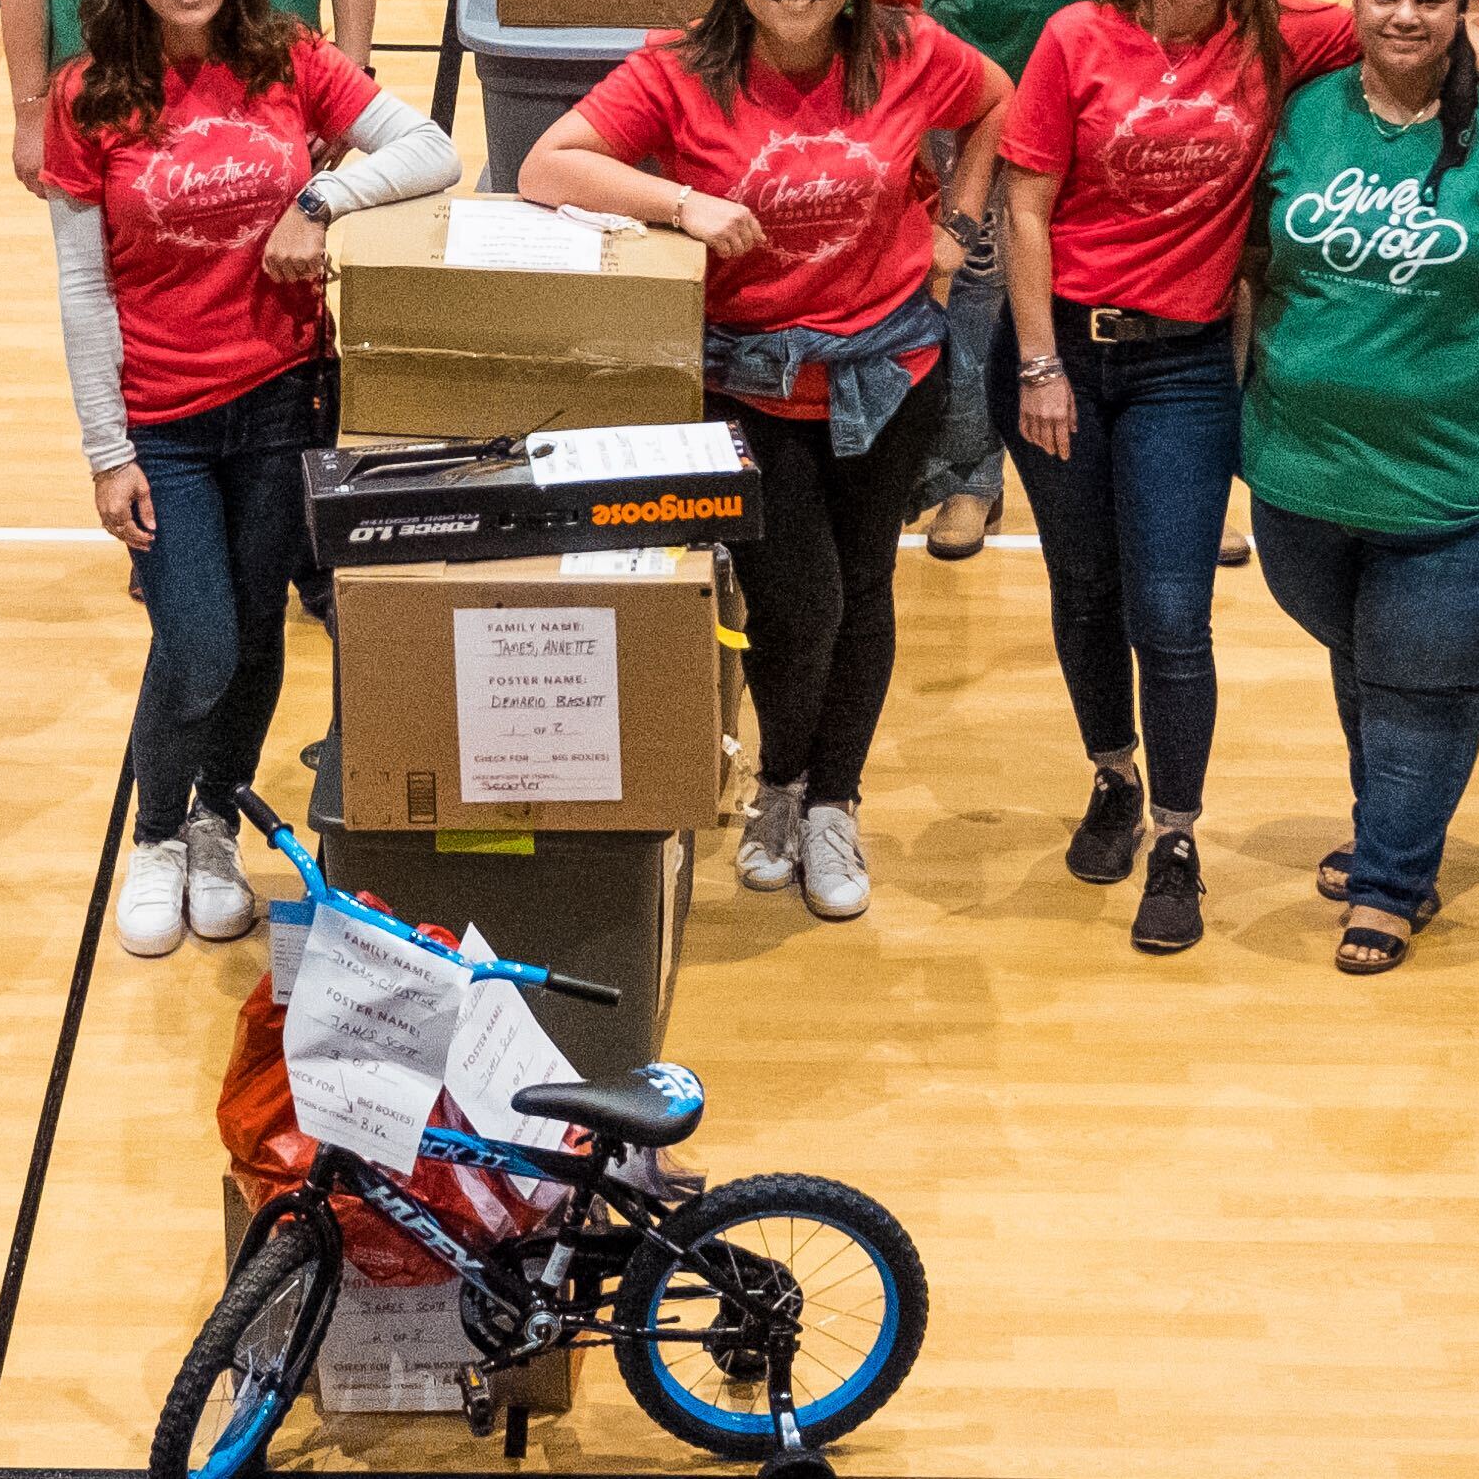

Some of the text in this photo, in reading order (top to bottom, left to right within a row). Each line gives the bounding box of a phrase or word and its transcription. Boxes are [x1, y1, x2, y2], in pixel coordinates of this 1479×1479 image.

[592, 494, 742, 526] mongoose
[348, 521, 480, 543] FORCE 1.0
[488, 622, 585, 632] FAMILY NAME:
[543, 639, 598, 655] ANNETTE
[489, 675, 587, 685] FOSTER NAME:
[344, 932, 435, 984] FAMILY NAME:
[326, 987, 422, 1037] FOSTER NAME:
[316, 1079, 335, 1093] FOR
[357, 1096, 373, 1110] BIG
[362, 1184, 485, 1271] HUFFY
